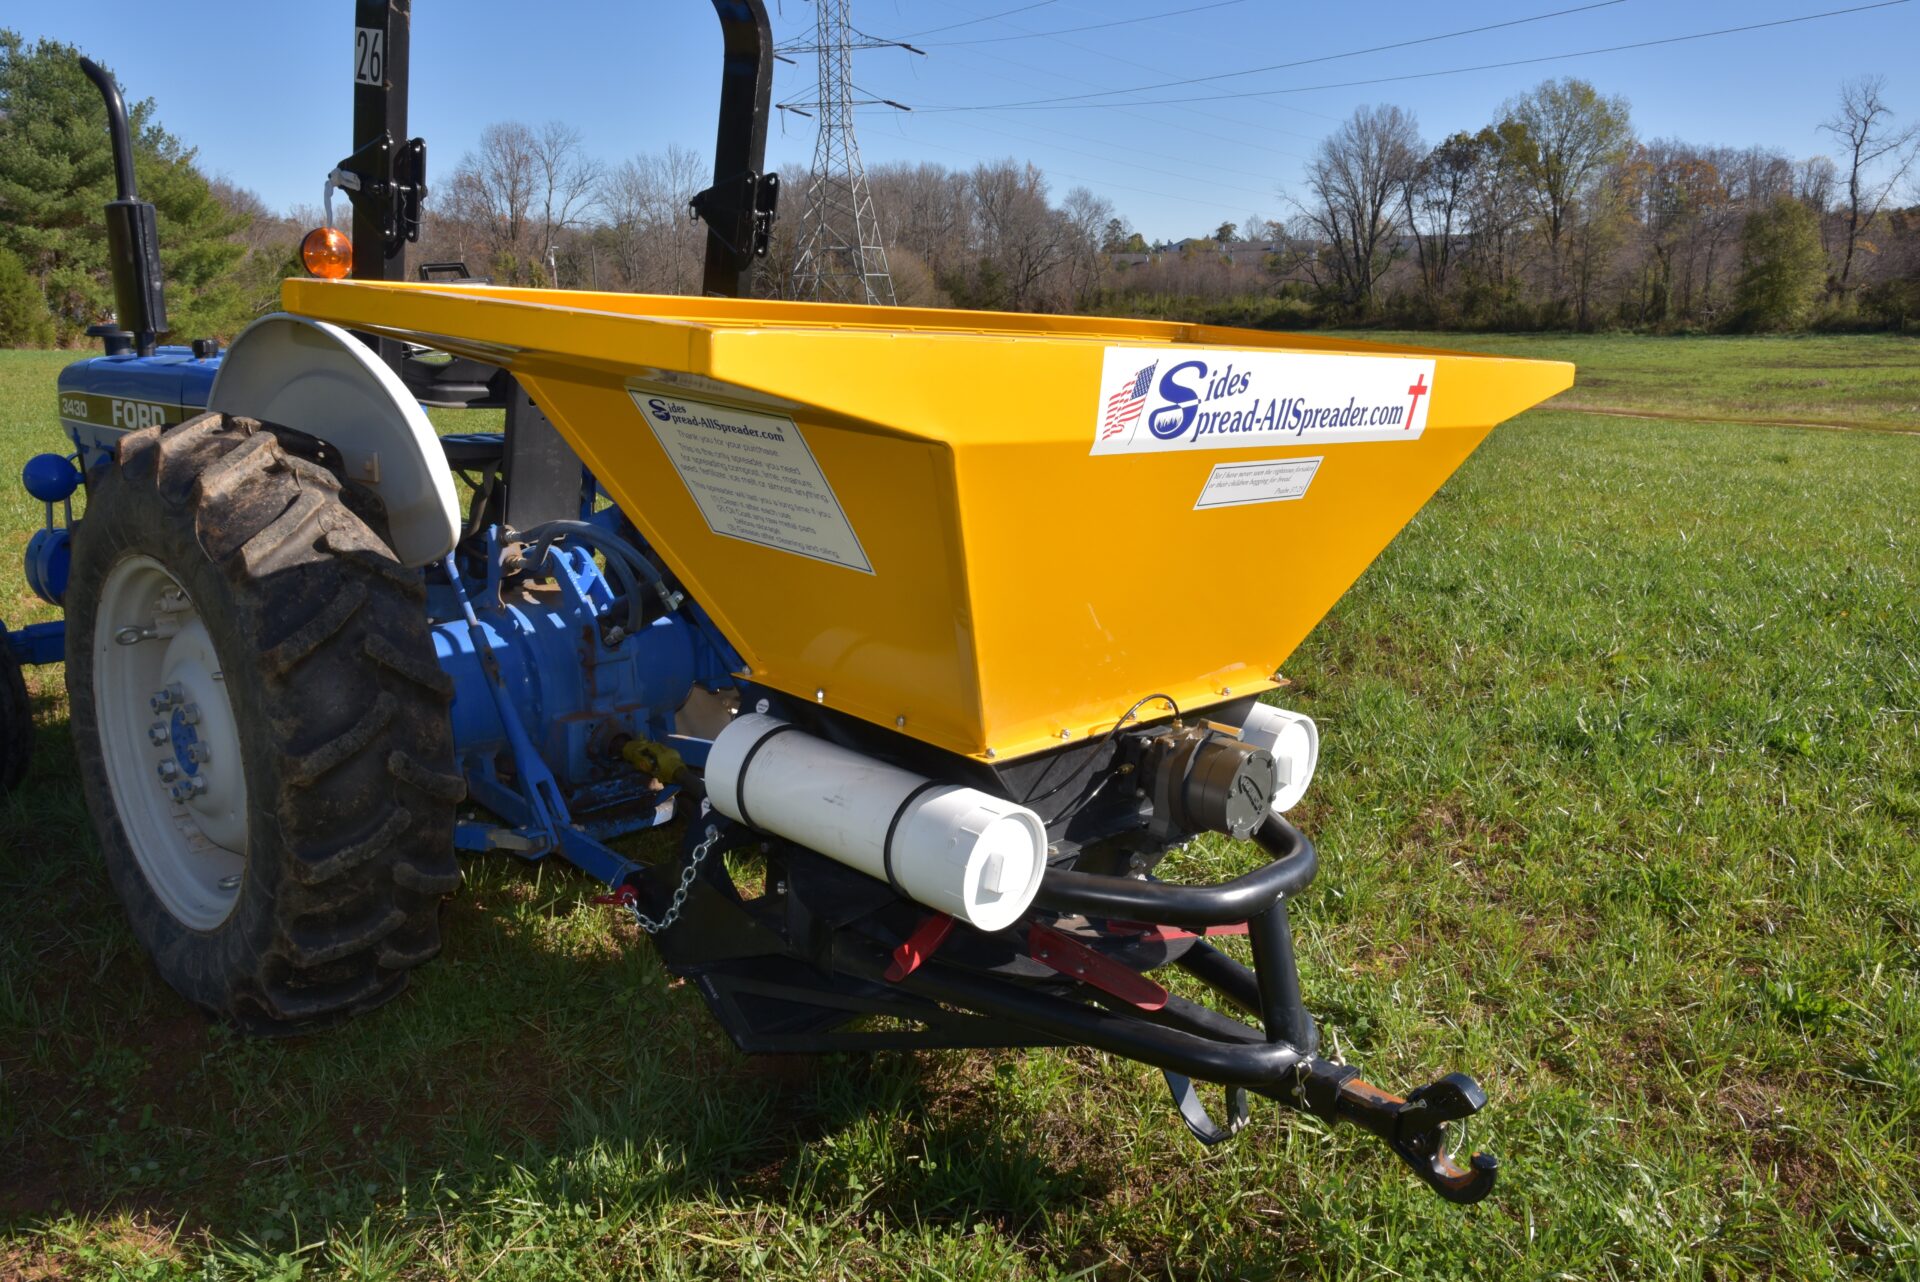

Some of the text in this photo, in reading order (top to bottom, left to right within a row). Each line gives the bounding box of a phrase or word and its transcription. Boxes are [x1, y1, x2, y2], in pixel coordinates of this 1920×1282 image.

[357, 31, 380, 82] 26
[62, 398, 166, 430] 3430 FORD
